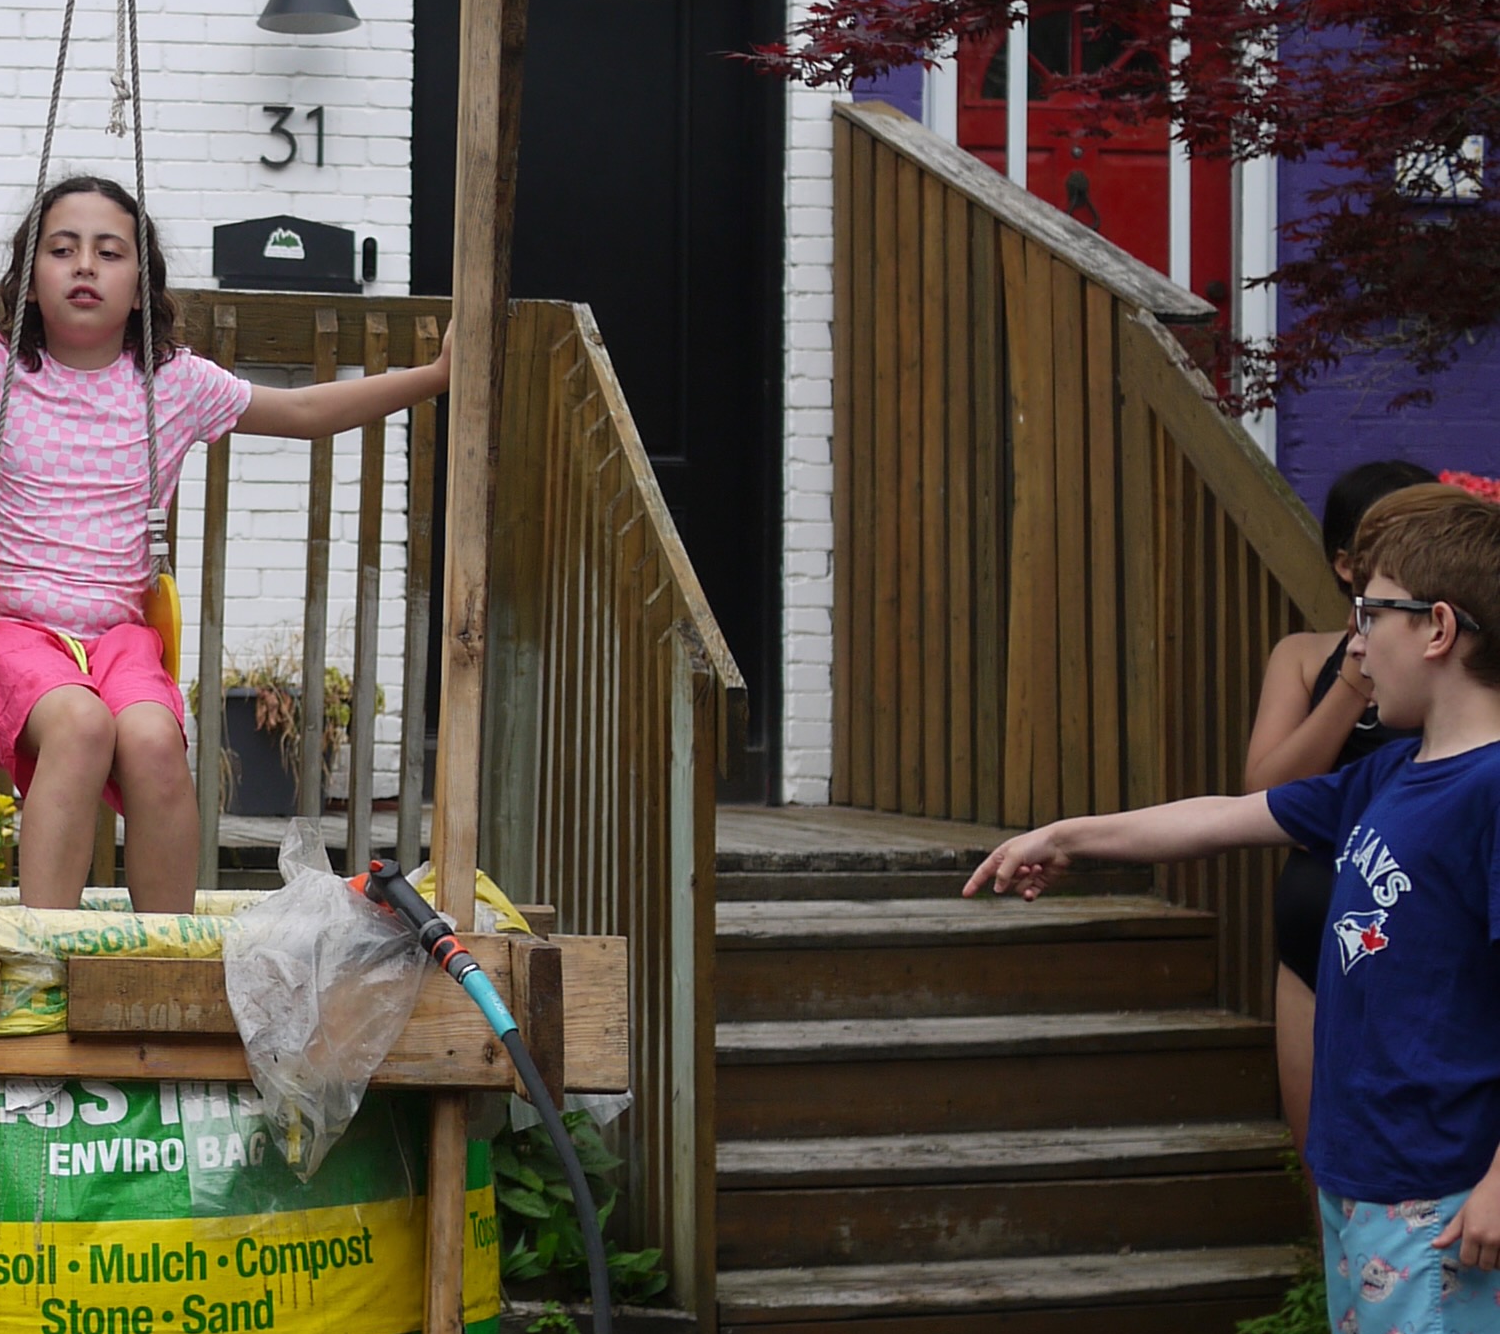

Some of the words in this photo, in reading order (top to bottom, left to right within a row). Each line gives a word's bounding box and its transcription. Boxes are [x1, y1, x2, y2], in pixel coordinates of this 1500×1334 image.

[260, 105, 325, 169] 31
[48, 1138, 186, 1176] ENVIRO
[197, 1131, 266, 1168] BAG
[89, 1242, 207, 1284] Mulch
[235, 1227, 374, 1280] Compost
[182, 1290, 275, 1334] Sand
